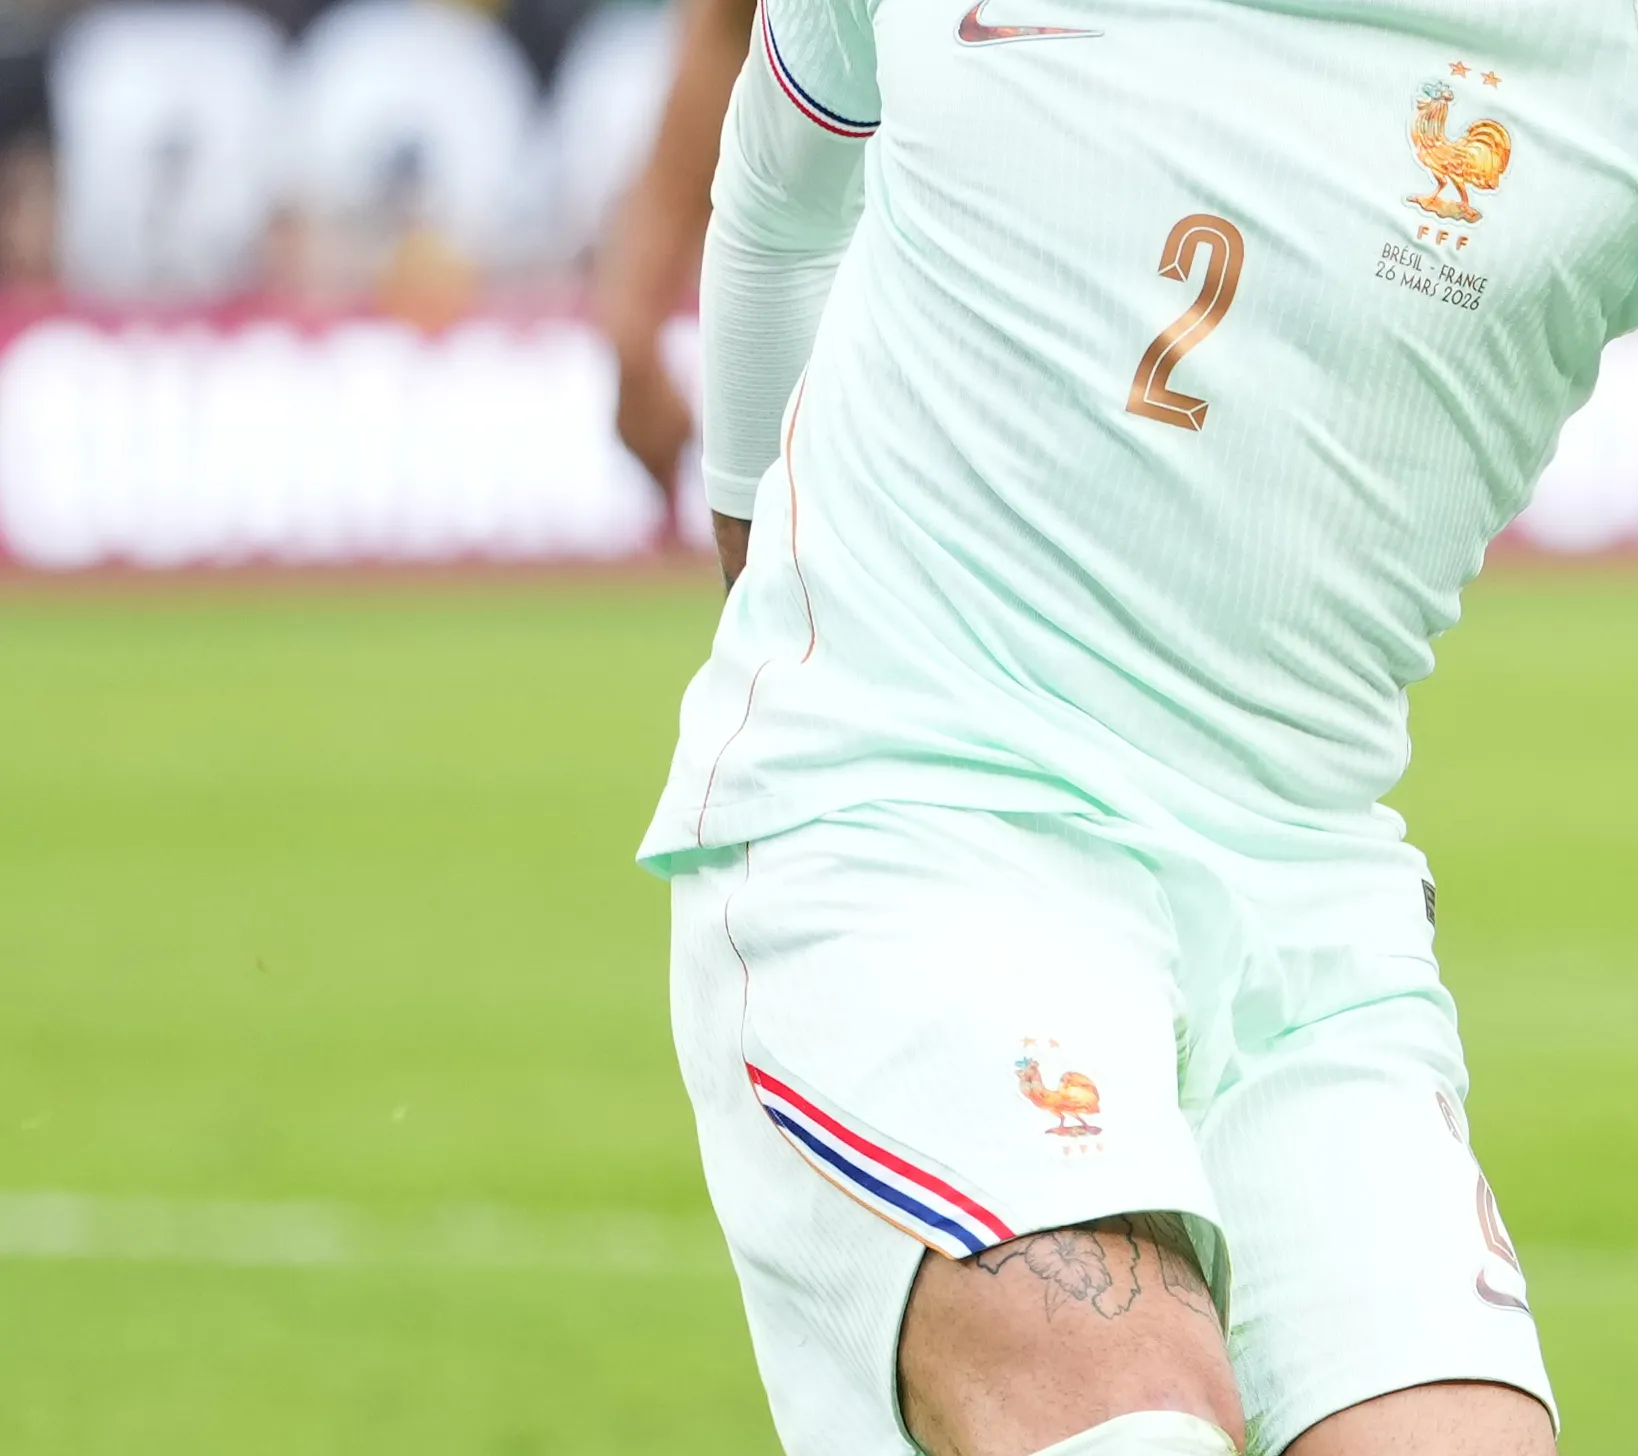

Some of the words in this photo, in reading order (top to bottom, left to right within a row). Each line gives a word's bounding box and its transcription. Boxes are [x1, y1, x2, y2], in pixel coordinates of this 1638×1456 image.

[1375, 261, 1396, 281] 26
[1400, 272, 1440, 297] MARS
[1441, 286, 1481, 311] 2026
[1381, 242, 1422, 272] BRÉSIL
[1438, 264, 1488, 294] FRANCE
[1125, 214, 1244, 431] 2
